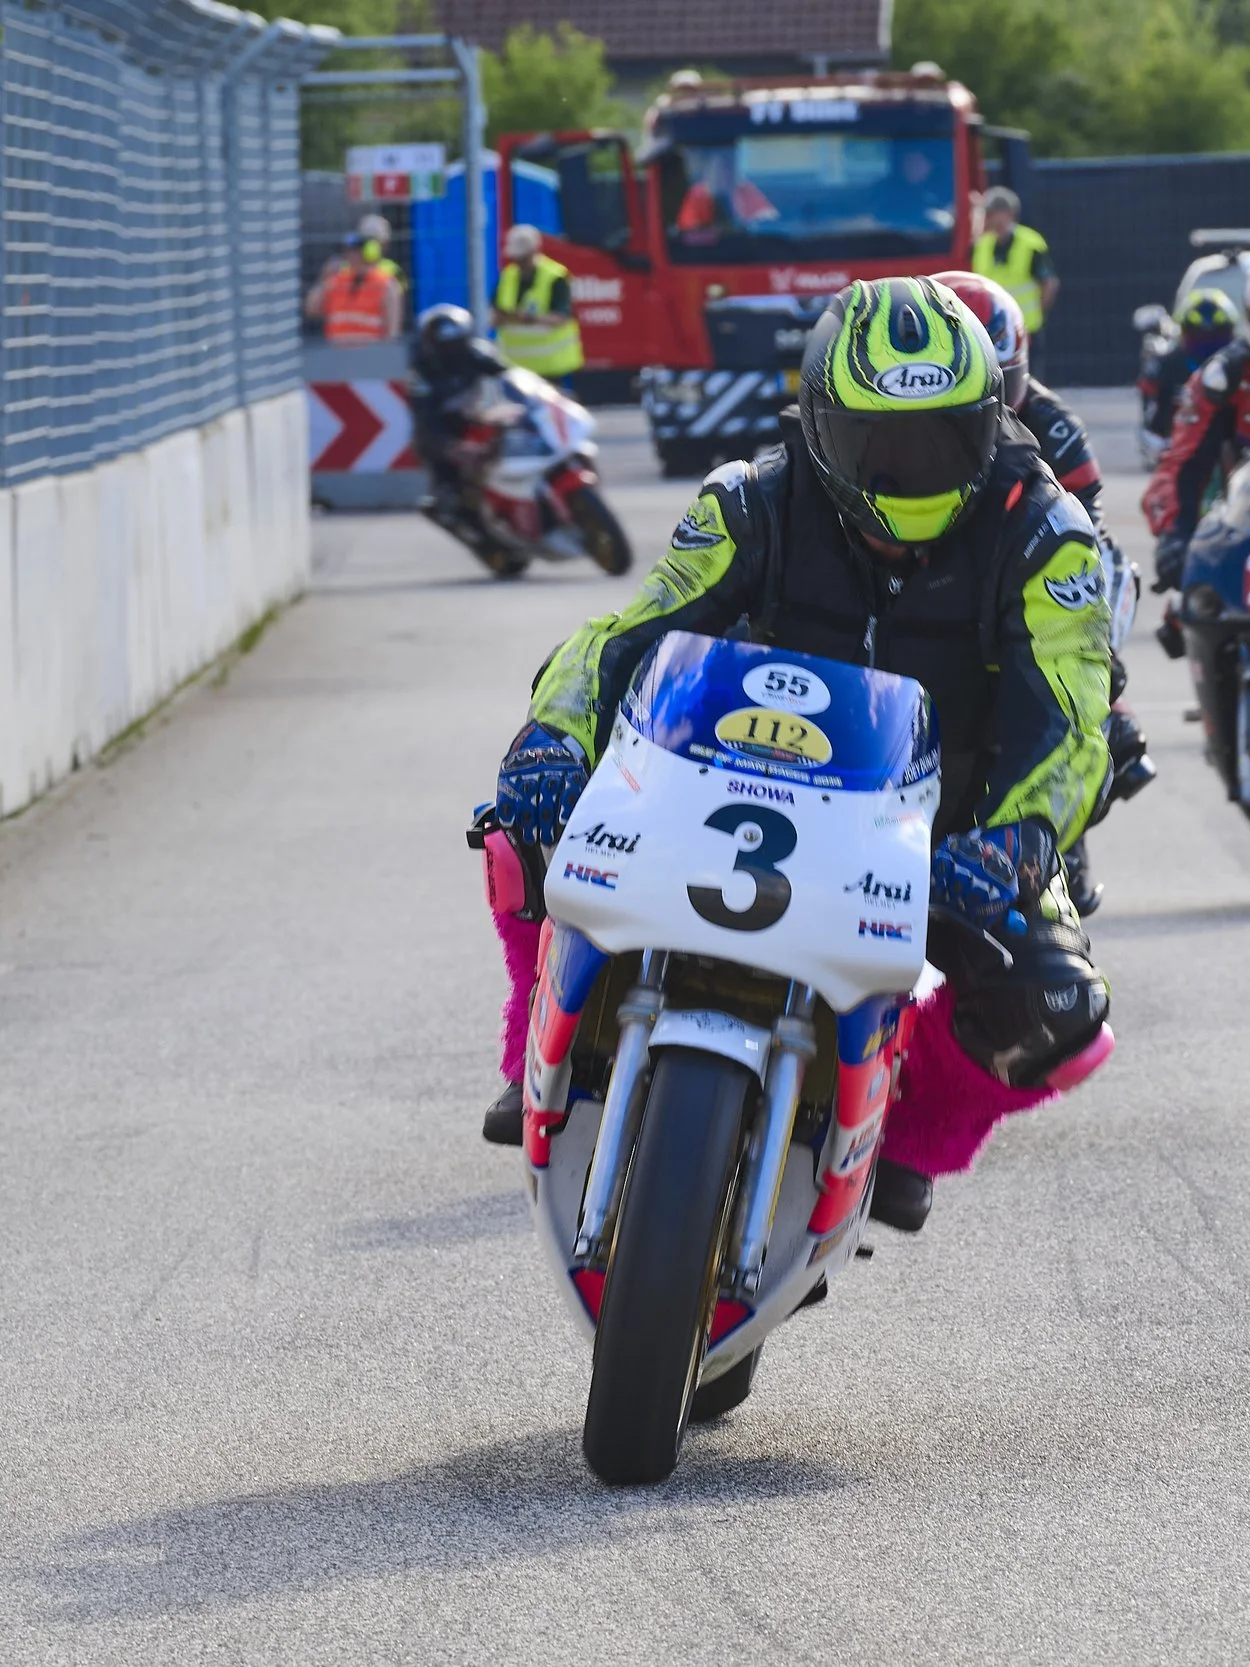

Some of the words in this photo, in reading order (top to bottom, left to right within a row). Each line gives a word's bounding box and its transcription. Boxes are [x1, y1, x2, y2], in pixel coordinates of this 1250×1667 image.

[883, 366, 943, 388] Arai
[763, 670, 810, 698] 55
[743, 714, 809, 754] 112
[727, 779, 796, 805] SHOWA
[568, 822, 642, 854] Arai
[563, 863, 619, 890] HRC
[686, 803, 798, 932] 3
[843, 870, 913, 903] Arai
[857, 918, 913, 944] HRC
